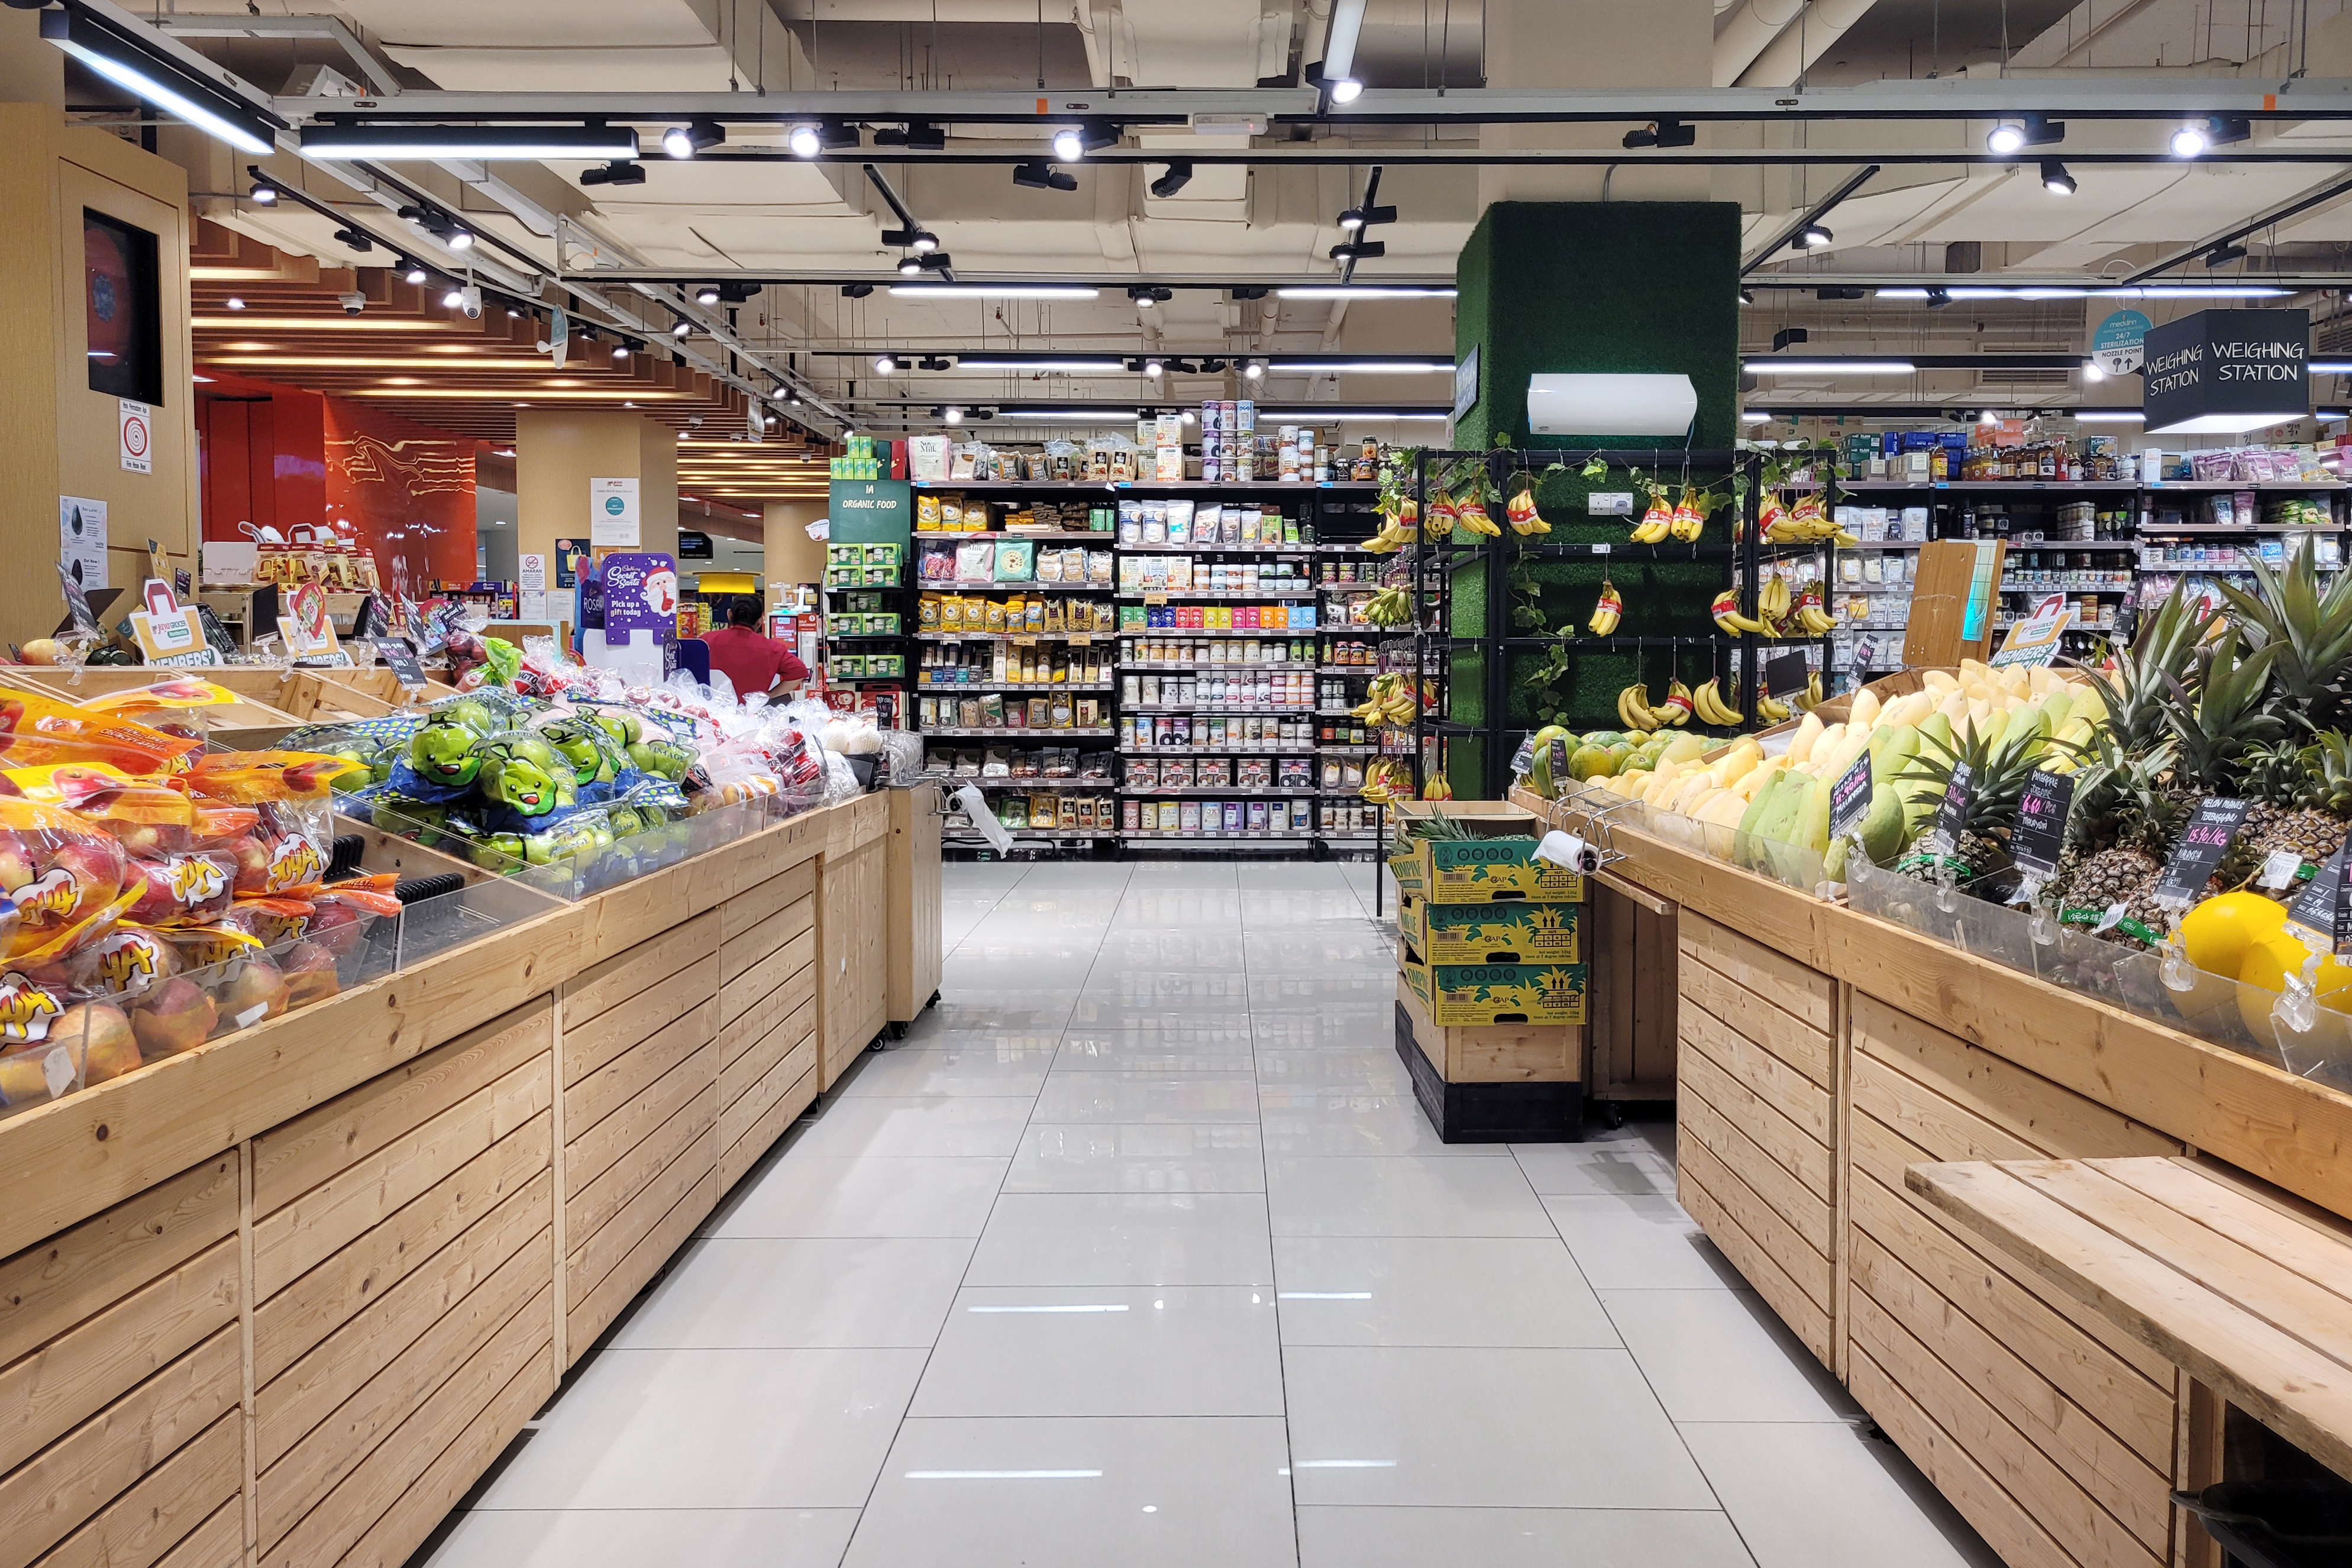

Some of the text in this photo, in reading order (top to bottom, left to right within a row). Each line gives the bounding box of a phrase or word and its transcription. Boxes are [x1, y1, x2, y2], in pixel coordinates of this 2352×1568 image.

[2101, 338, 2144, 349] STERILIZATION
[2211, 342, 2305, 360] WEIGHING
[2102, 349, 2123, 357] NOZZLE
[2146, 344, 2203, 376] WEIGHING
[2218, 364, 2298, 382] STATION
[2150, 367, 2199, 396] STATION
[865, 484, 874, 494] 1A
[842, 500, 897, 509] ORGANIC FOOD
[607, 566, 638, 587] Secret
[618, 579, 641, 589] Santa
[583, 597, 603, 613] ROSES
[610, 609, 641, 617] gift today
[158, 620, 187, 634] Jaya GROCER
[150, 648, 215, 667] MEMBERS'
[1994, 642, 2057, 665] MEMBERS'
[2031, 769, 2059, 788] PINEAPPLE
[1837, 781, 1867, 813] MALAYSIA
[2201, 798, 2245, 810] MELON MANIS
[2022, 817, 2048, 830] MALAYSIA
[2201, 810, 2238, 822] TERENGGANU
[2177, 848, 2202, 861] MALAYSIA
[268, 840, 321, 888] JOYA
